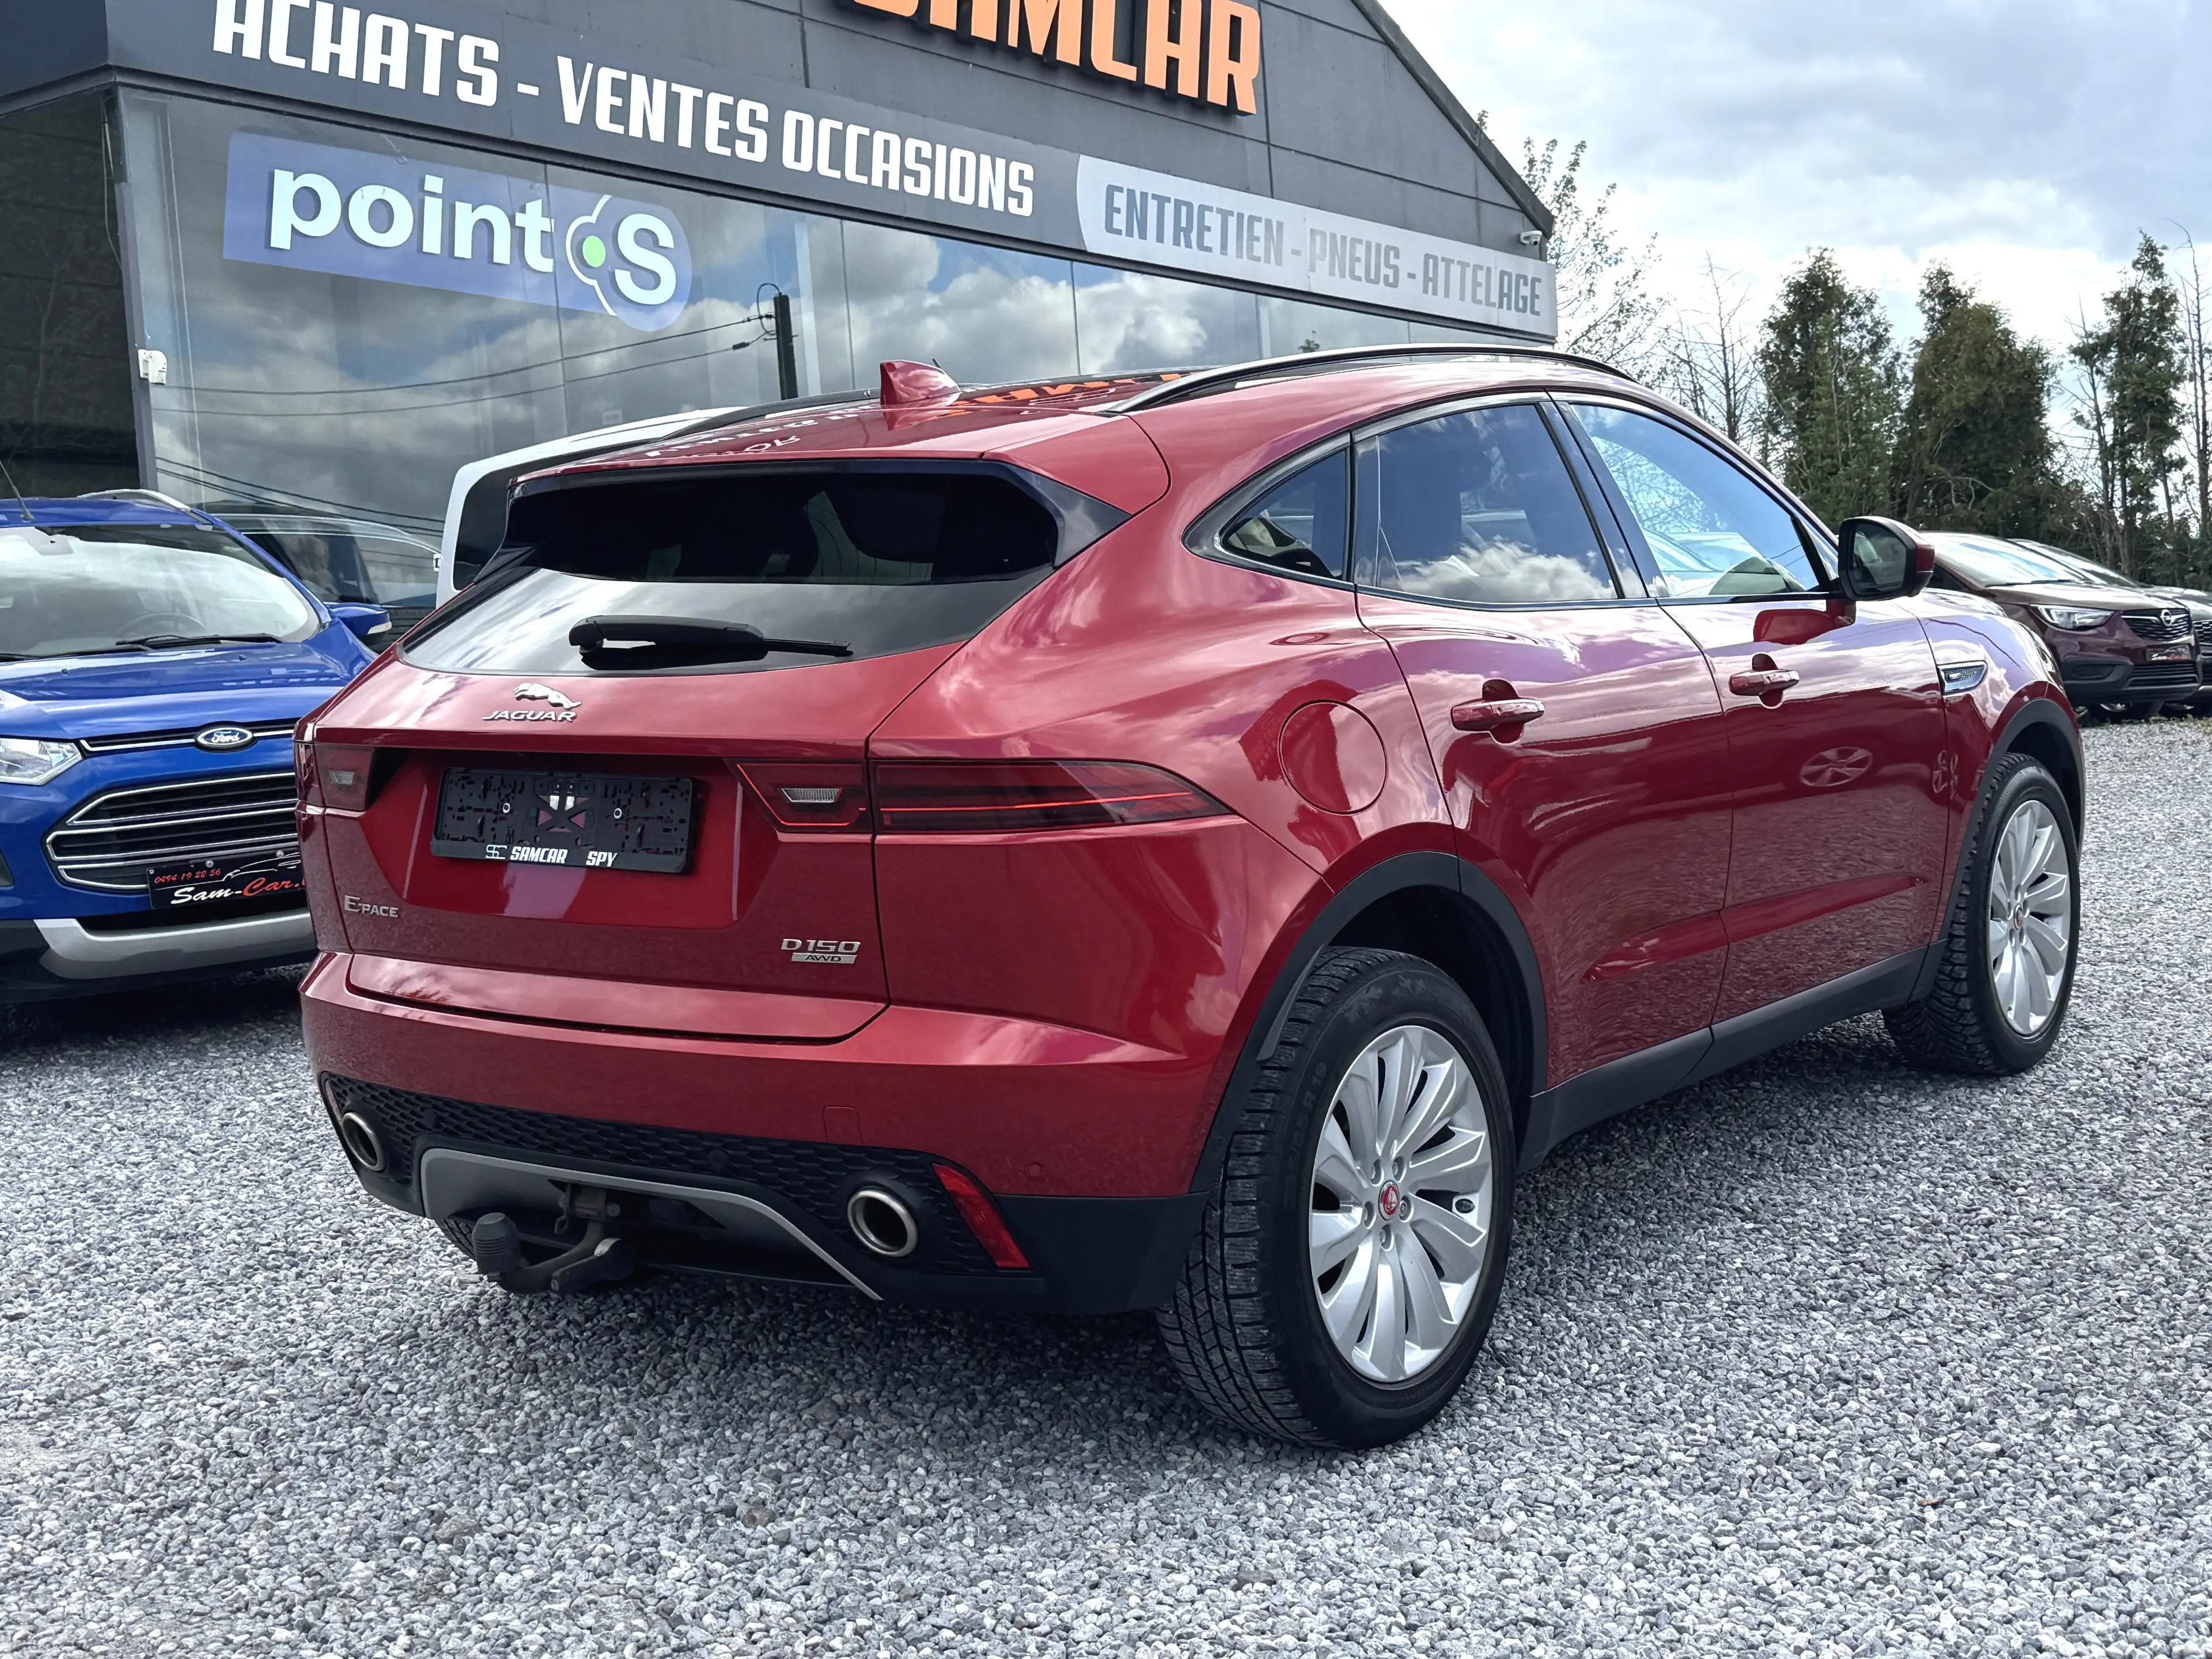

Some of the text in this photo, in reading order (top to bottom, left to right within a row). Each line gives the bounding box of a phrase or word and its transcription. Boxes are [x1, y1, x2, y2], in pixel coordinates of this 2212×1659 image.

[853, 0, 1260, 114] MCAR
[213, 0, 499, 107] ACHATS
[556, 55, 769, 163] VENTES
[782, 109, 1035, 217] OCCASIONS
[270, 169, 677, 305] point S
[1104, 184, 1284, 266] ENTRETIEN
[1309, 228, 1400, 289] PNEUS
[1422, 252, 1542, 317] ATTELAGE
[482, 710, 577, 722] JAGUAR
[211, 730, 240, 743] Ford
[510, 846, 569, 864] SAMCAR
[585, 851, 618, 867] SPY
[209, 868, 222, 876] 56
[805, 954, 842, 962] AWD
